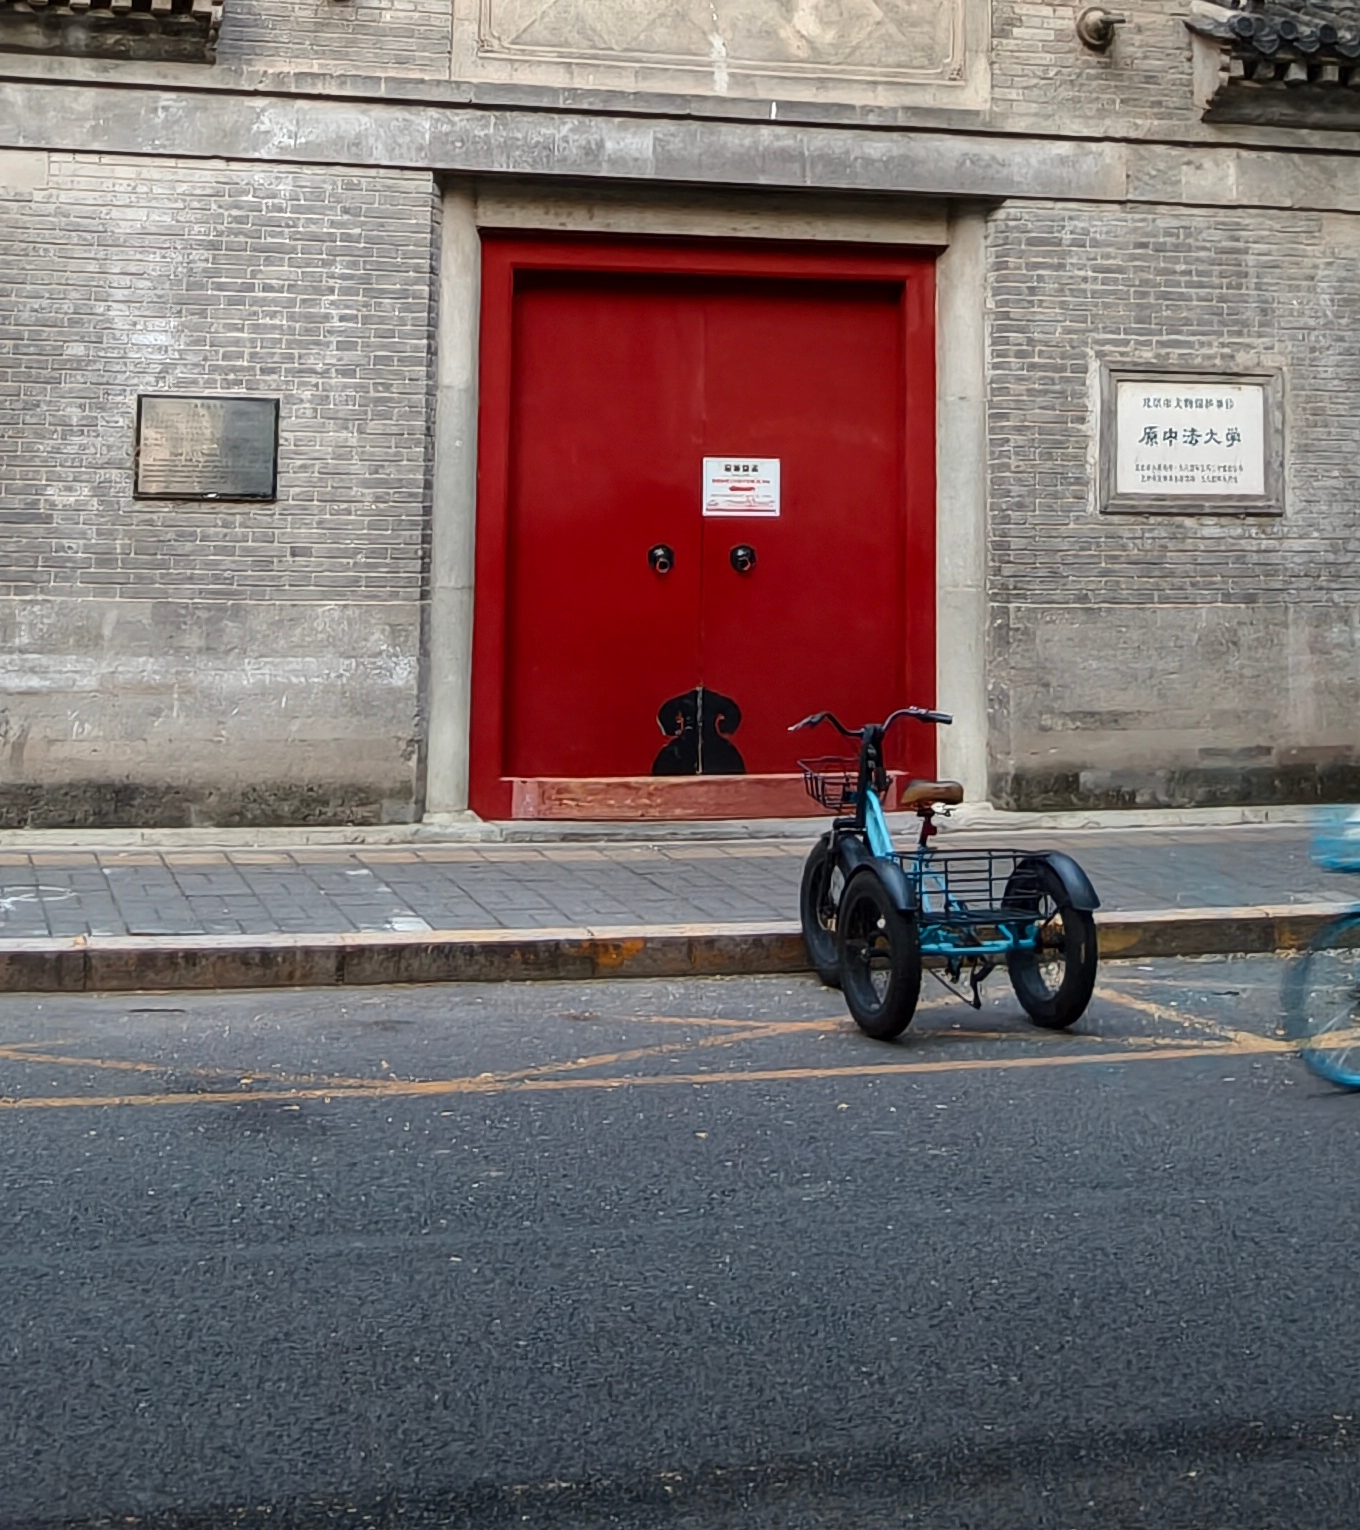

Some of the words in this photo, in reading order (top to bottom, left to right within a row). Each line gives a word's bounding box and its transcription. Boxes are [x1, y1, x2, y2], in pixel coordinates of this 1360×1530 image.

[1138, 426, 1242, 448] 原中法大学
